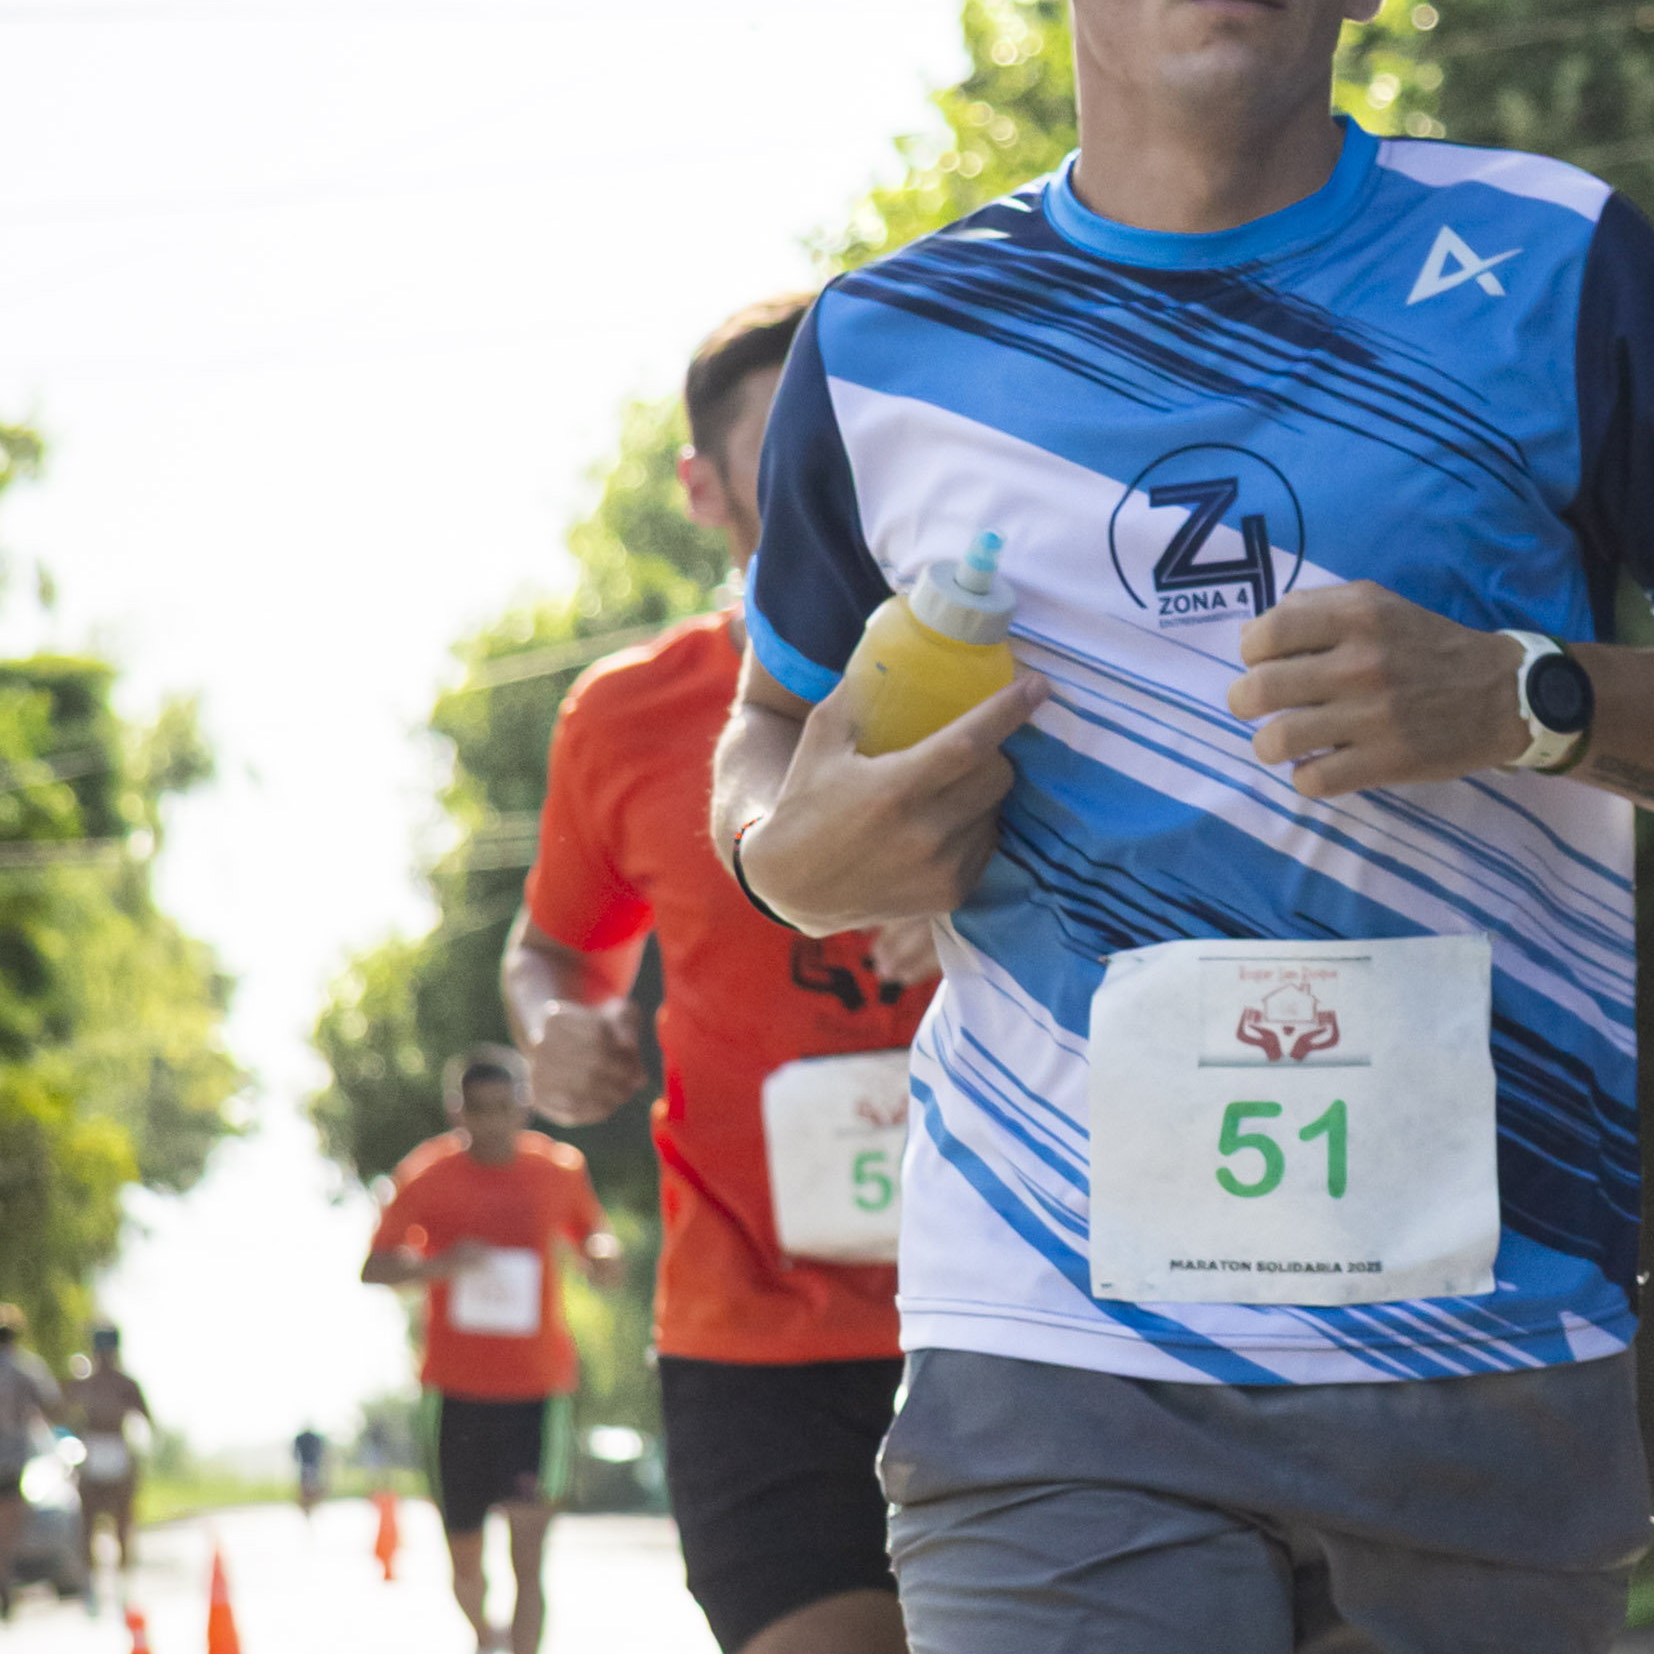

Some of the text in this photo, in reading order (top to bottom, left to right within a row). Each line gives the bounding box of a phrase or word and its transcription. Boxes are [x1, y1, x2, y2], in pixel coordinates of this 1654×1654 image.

[1158, 587, 1249, 615] ZONA 4
[1215, 1099, 1348, 1199] 51
[852, 1150, 894, 1213] 5
[1170, 1259, 1251, 1272] MARATON
[1257, 1260, 1343, 1273] SOLIDARIA
